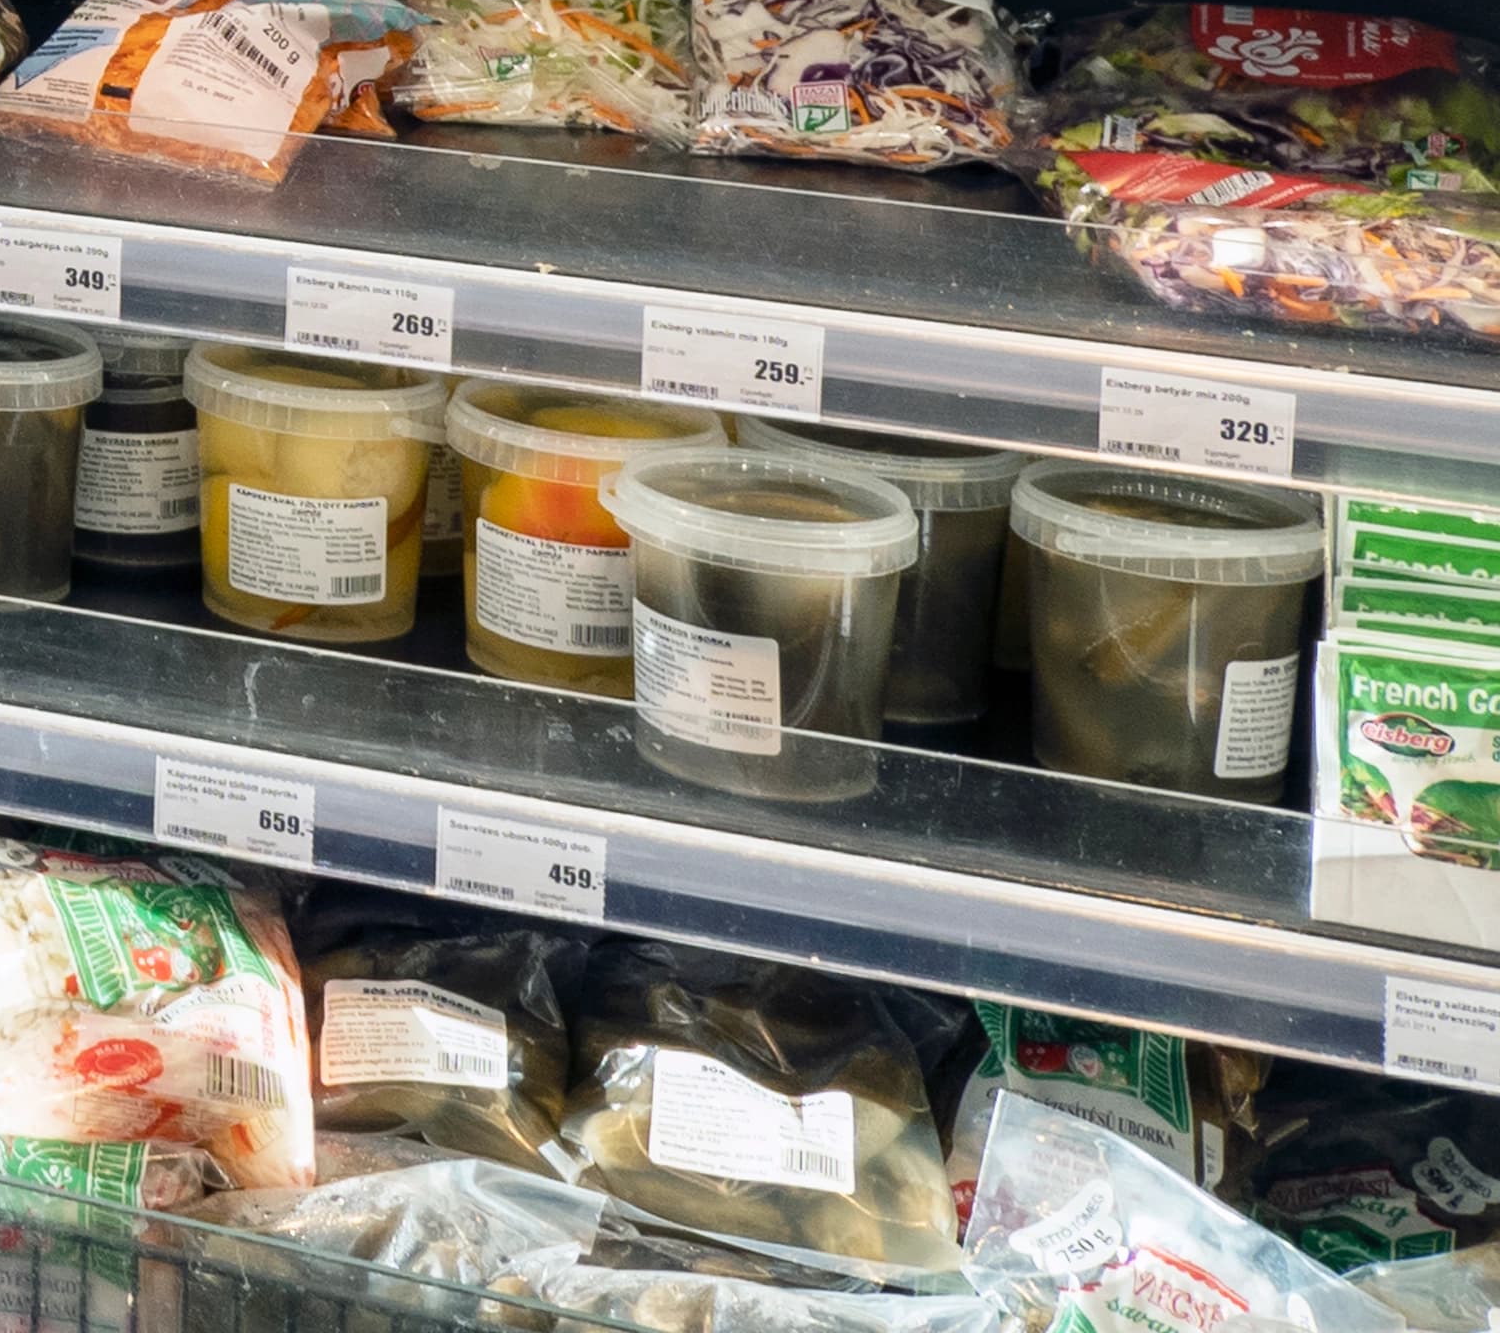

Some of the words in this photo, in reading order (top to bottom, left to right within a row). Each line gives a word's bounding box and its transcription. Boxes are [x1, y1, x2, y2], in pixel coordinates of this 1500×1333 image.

[262, 22, 291, 51] 200
[1354, 674, 1457, 715] French
[1361, 720, 1449, 754] eisberg
[1118, 1123, 1175, 1151] UBORKA
[1056, 1238, 1091, 1263] 750
